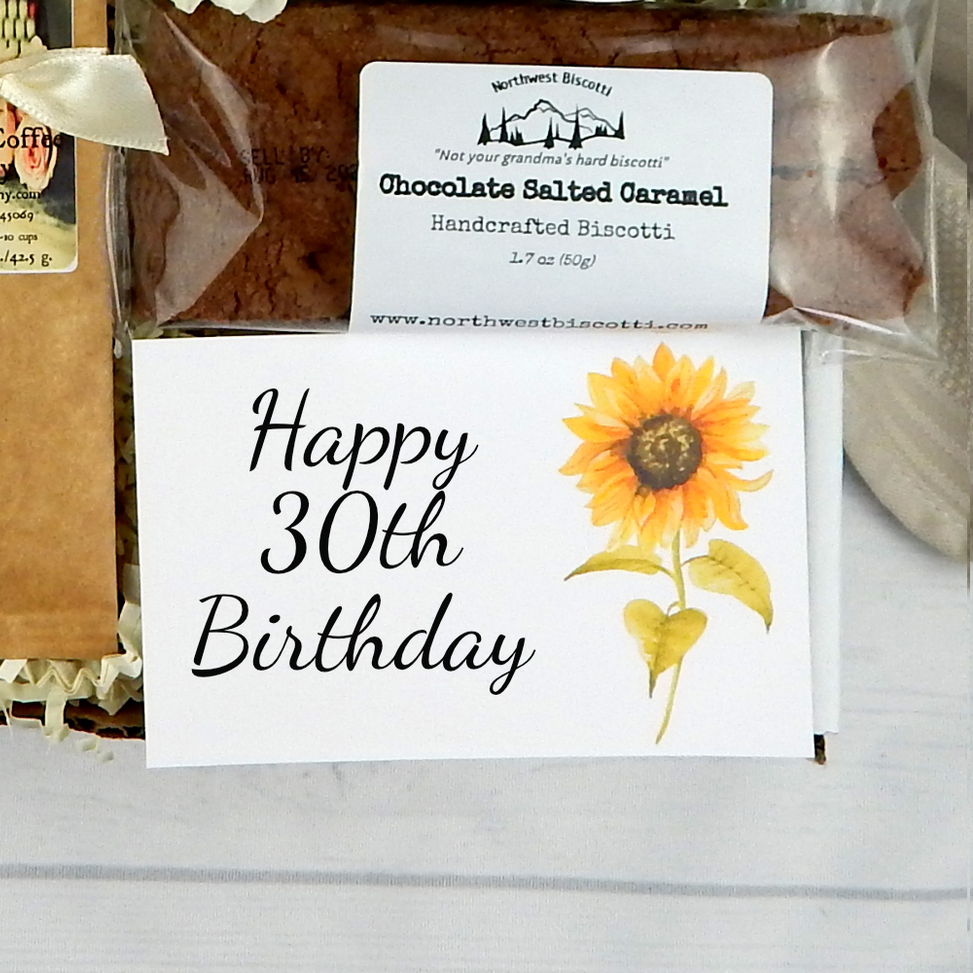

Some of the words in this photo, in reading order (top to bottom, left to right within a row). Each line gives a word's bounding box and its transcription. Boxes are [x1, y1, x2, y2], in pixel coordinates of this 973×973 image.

[490, 71, 558, 94] Northwest
[562, 71, 613, 97] Biscotti
[434, 147, 465, 163] "Not
[467, 150, 500, 165] your
[500, 150, 573, 168] grandma's
[574, 153, 608, 167] hard
[610, 154, 671, 169] biscotti"
[378, 173, 516, 200] Chocolate
[522, 178, 613, 204] Salted
[620, 180, 730, 208] Caramel
[0, 209, 35, 223] 45069
[430, 214, 570, 238] Handcrafted
[577, 219, 676, 241] Biscotti
[18, 233, 38, 245] cups
[41, 253, 53, 268] g.
[508, 251, 535, 266] 1.7
[536, 255, 556, 267] oz
[558, 252, 597, 271] (50g)
[369, 312, 709, 331] www.northwestbiscotti.com
[248, 387, 479, 491] Happy
[259, 487, 465, 576] 30th
[190, 591, 538, 696] Birthday
